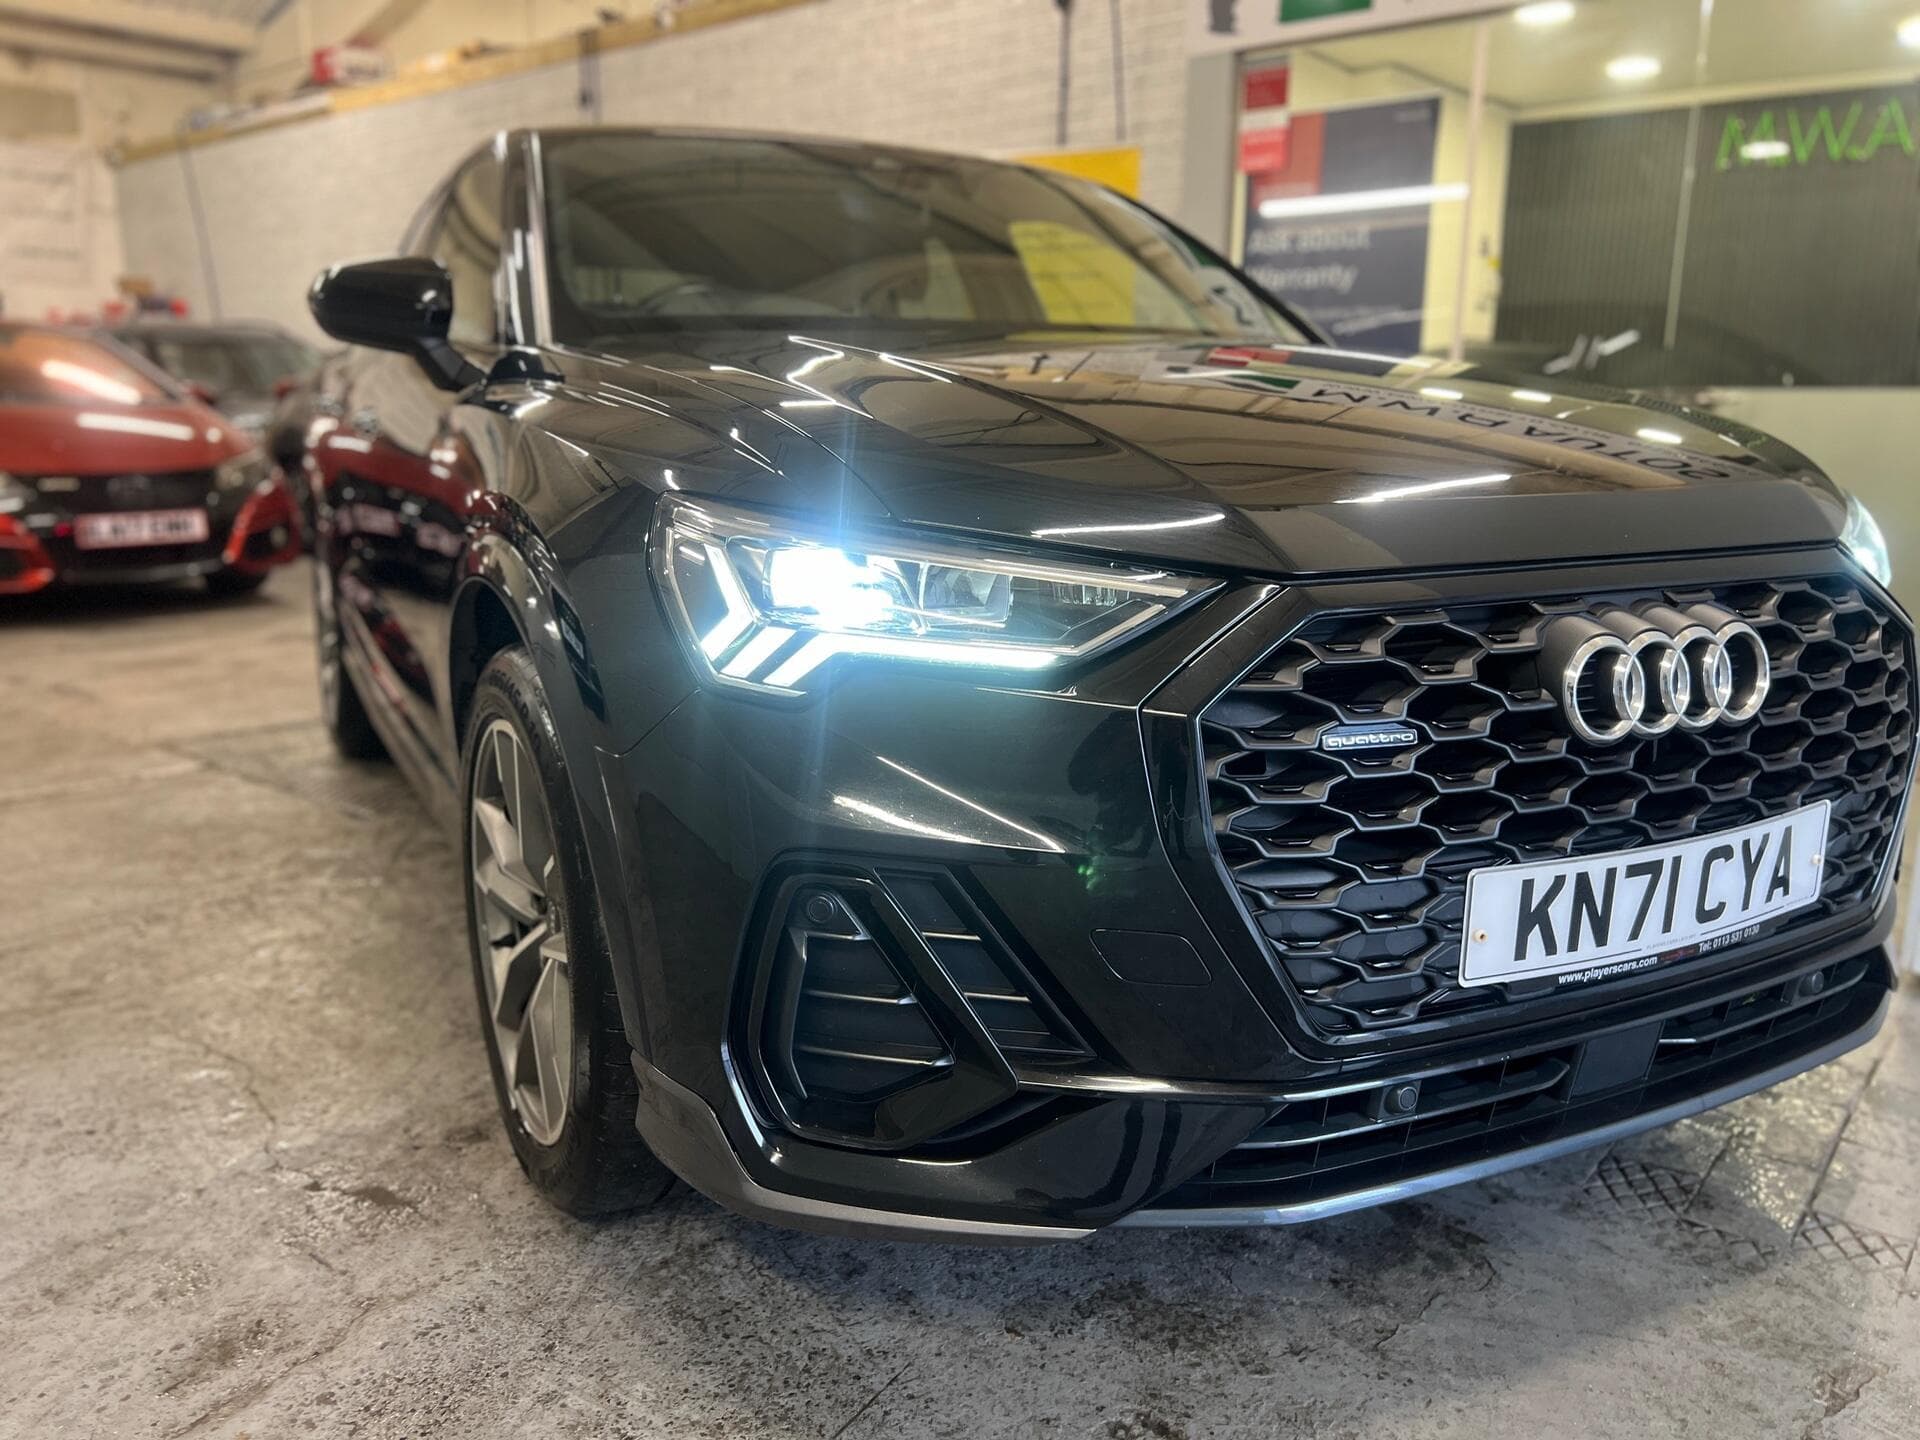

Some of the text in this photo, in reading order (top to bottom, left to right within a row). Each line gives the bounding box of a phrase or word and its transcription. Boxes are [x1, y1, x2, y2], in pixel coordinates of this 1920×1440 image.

[1715, 96, 1915, 172] MWA
[1327, 732, 1415, 748] quattro
[1513, 825, 1793, 962] KN71 CYA
[1558, 956, 1658, 984] www.playerscars.com
[1698, 941, 1712, 953] Tel:
[1712, 934, 1730, 949] 0113
[1731, 929, 1743, 943] 531
